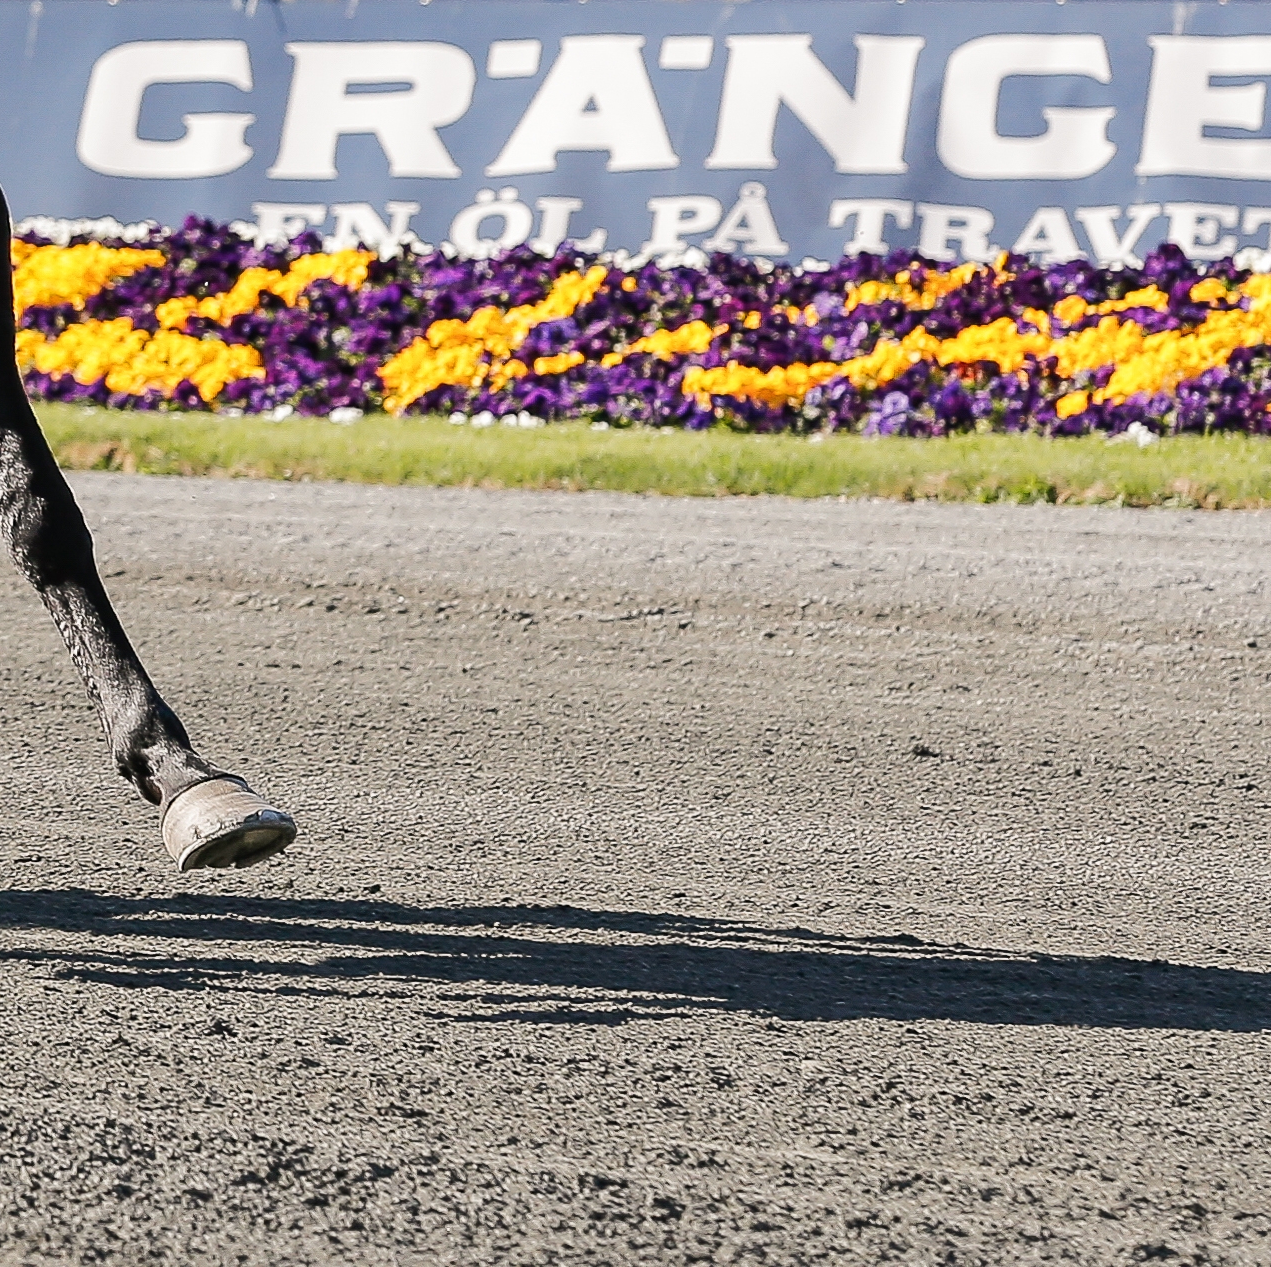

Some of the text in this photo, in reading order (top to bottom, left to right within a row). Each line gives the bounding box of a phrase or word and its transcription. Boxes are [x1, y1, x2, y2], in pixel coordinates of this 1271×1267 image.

[75, 32, 1271, 183] GRÄNGE
[251, 199, 425, 261] EN
[448, 186, 607, 261] ÖL
[637, 181, 790, 257] PÅ
